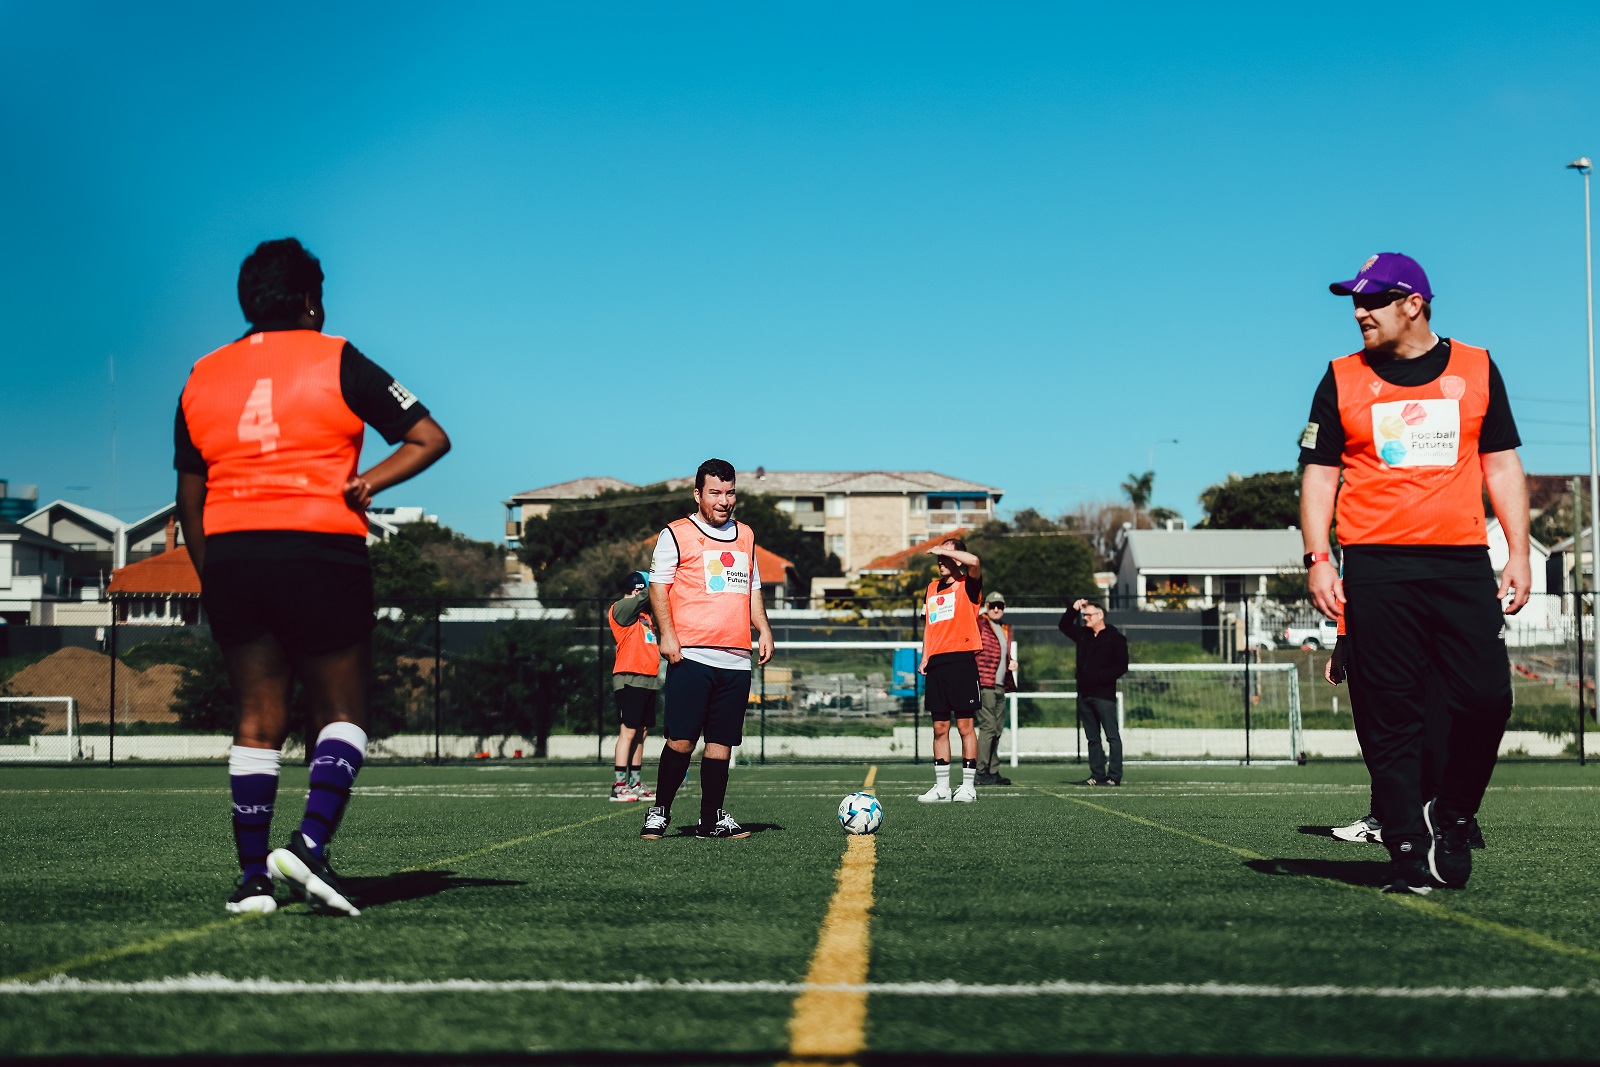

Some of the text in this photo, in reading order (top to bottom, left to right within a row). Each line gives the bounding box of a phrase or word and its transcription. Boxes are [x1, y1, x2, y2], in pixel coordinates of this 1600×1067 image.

[237, 378, 280, 455] 4
[1412, 431, 1456, 440] Football
[1412, 441, 1454, 450] Futures
